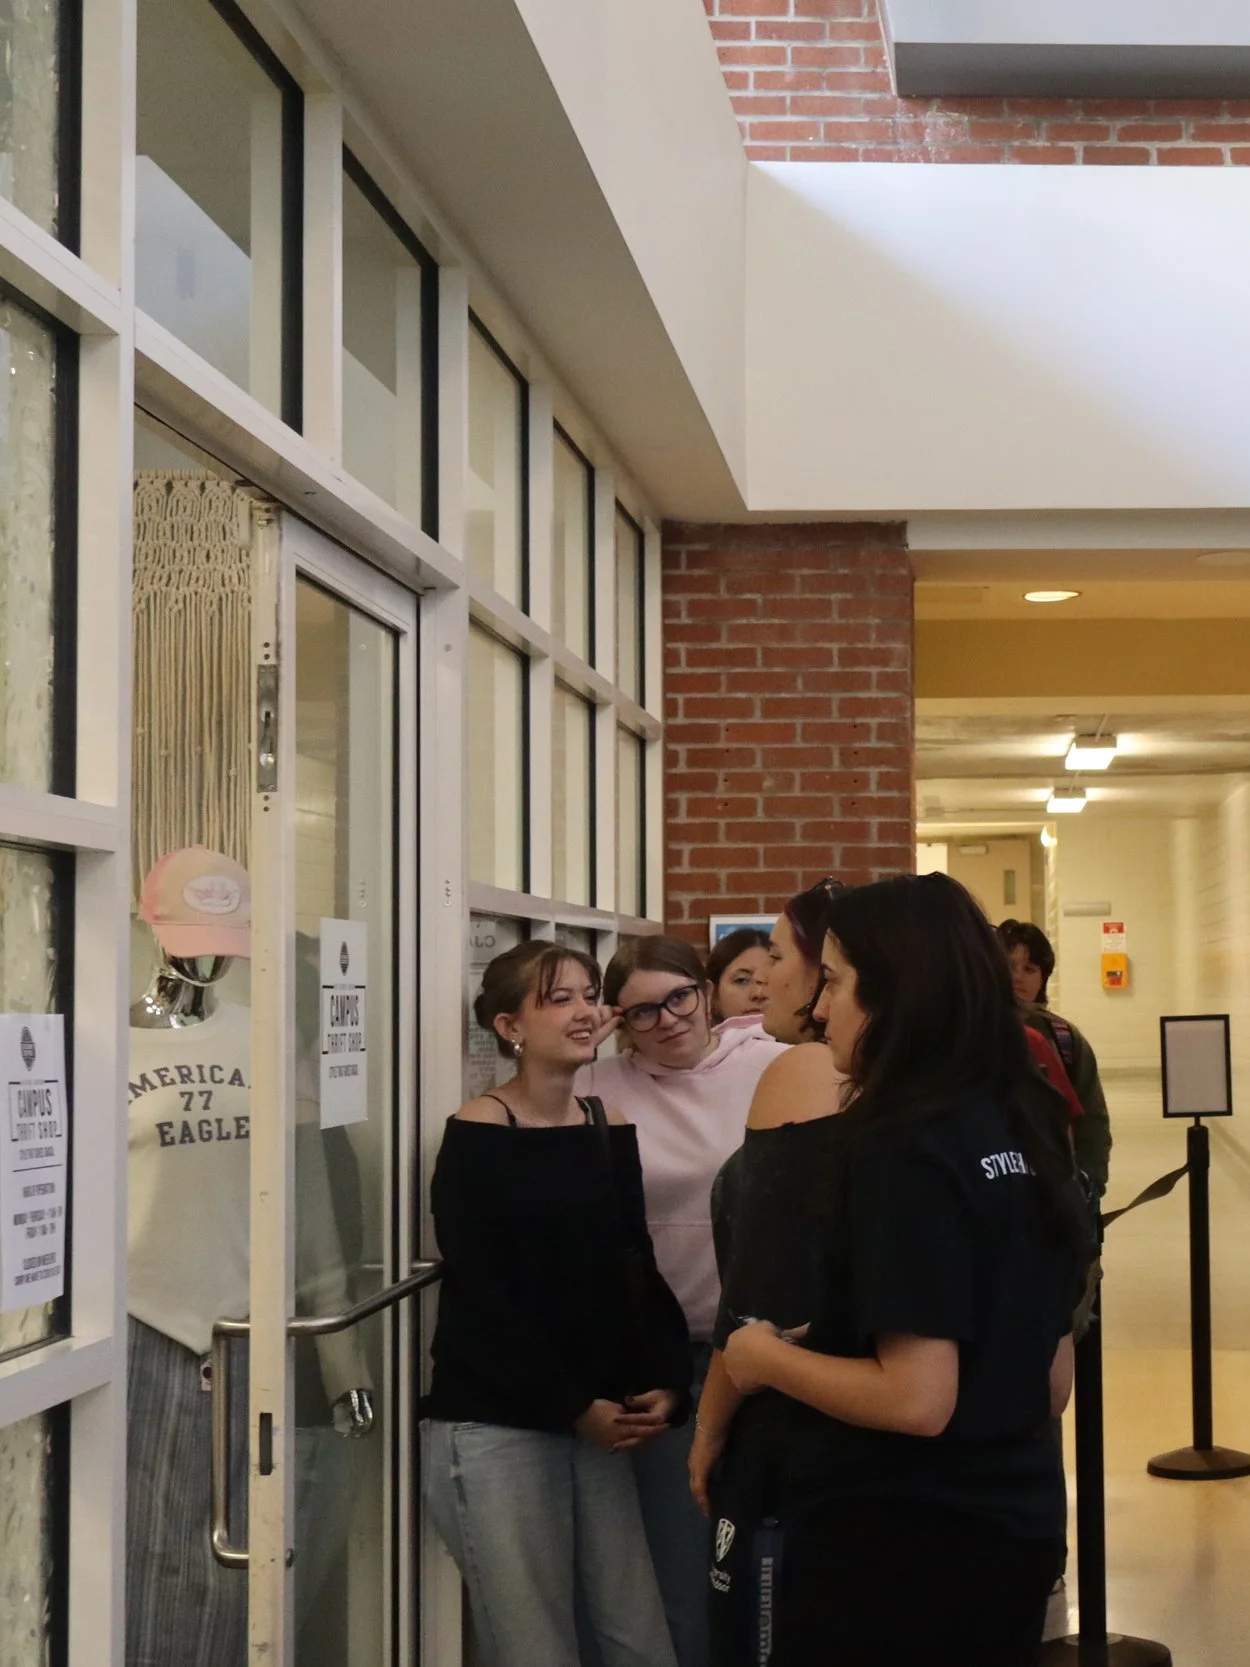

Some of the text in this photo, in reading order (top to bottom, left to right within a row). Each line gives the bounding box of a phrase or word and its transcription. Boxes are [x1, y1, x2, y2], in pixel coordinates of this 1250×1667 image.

[330, 995, 359, 1028] CAMPUS
[128, 1064, 251, 1105] MERICA
[18, 1088, 53, 1118] CAMPUS
[179, 1090, 213, 1112] 77
